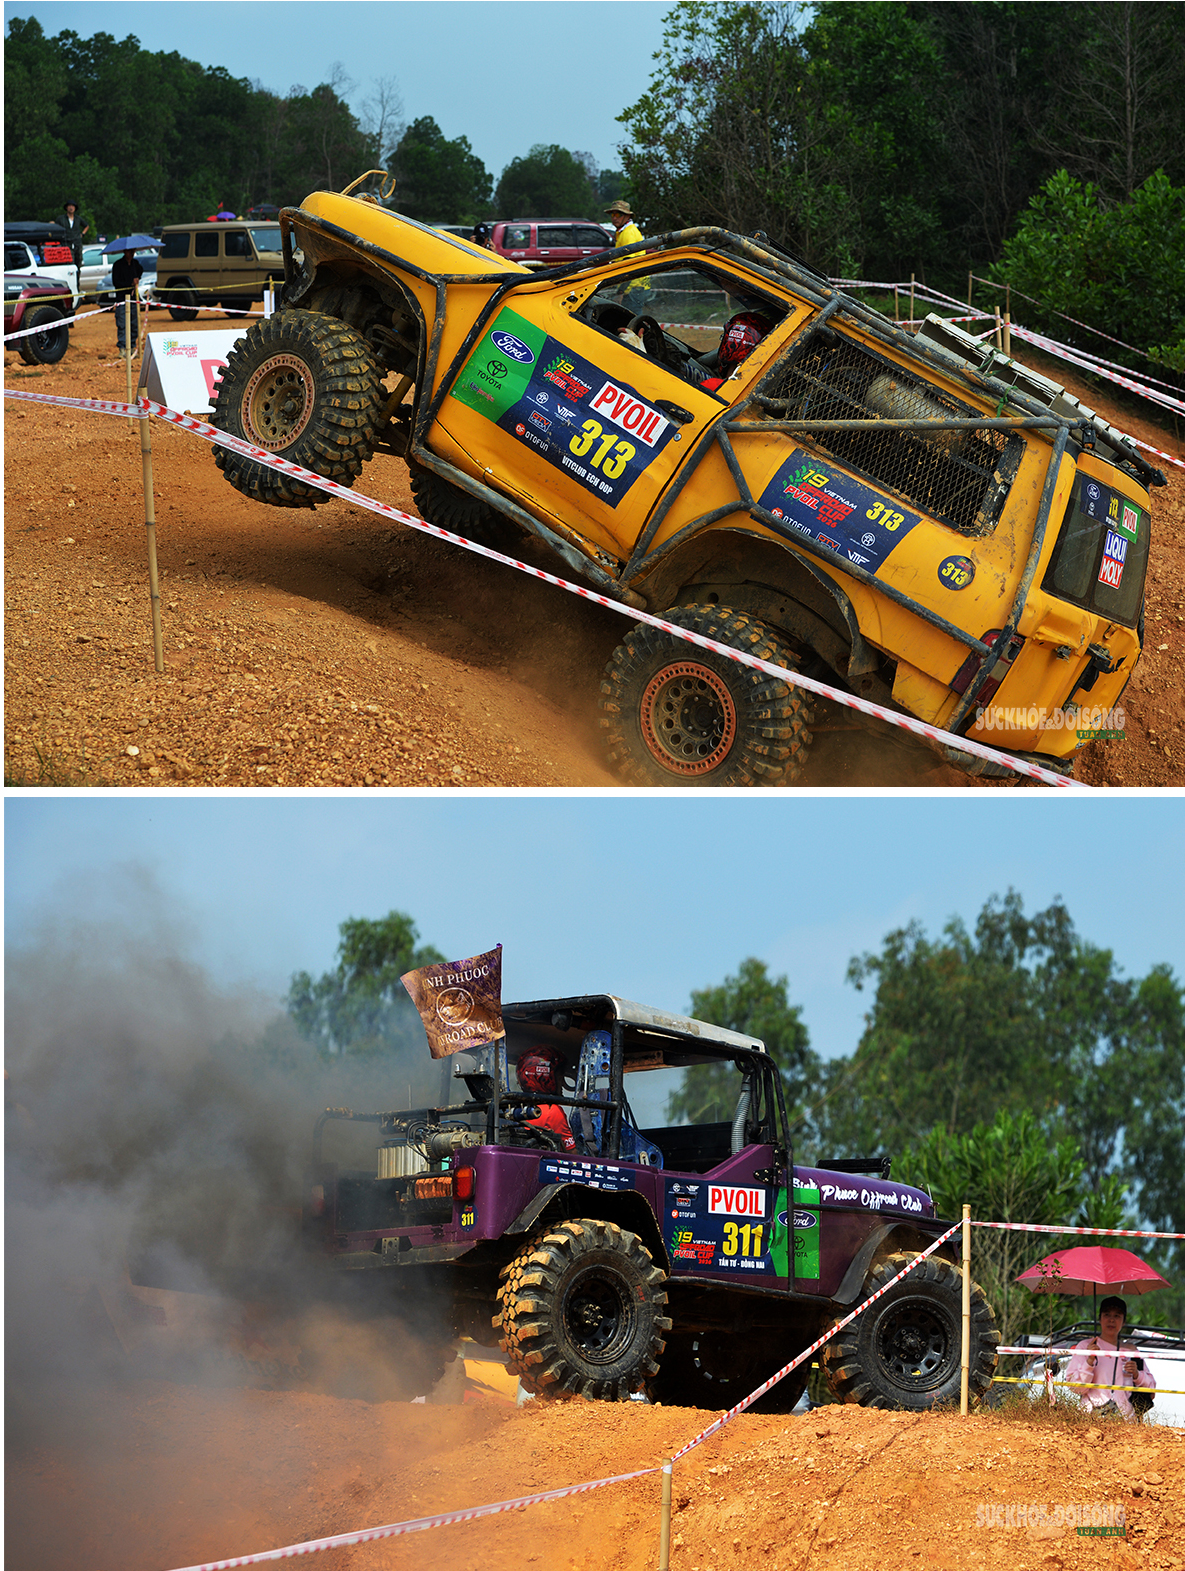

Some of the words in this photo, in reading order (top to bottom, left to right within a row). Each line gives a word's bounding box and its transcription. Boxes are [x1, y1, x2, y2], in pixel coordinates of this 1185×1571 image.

[497, 335, 527, 360] Ford
[556, 359, 575, 375] 19
[477, 370, 502, 390] TOYOTA
[543, 370, 568, 390] PVOIL
[565, 385, 584, 398] CUP
[553, 369, 590, 395] OFFROAD
[570, 373, 593, 390] VIETNAM
[593, 384, 661, 444] PVOIL
[568, 418, 636, 480] 313
[802, 468, 830, 488] 19
[783, 484, 820, 511] PVOIL
[817, 504, 846, 522] CUP
[797, 481, 854, 516] OFFROAD
[823, 487, 858, 510] VIETNAM
[816, 513, 838, 529] 2026
[865, 501, 905, 532] 313
[1122, 507, 1137, 533] PVOIL
[1105, 532, 1127, 562] LIQUI
[941, 562, 969, 586] 313
[1100, 558, 1123, 586] MOLY
[447, 964, 490, 985] PHUOC
[711, 1187, 763, 1215] PVOIL
[900, 1194, 923, 1213] Club
[461, 1212, 474, 1227] 311
[677, 1231, 694, 1243] 19
[679, 1242, 715, 1252] OFFROAD
[722, 1221, 764, 1257] 311
[673, 1249, 697, 1259] PVOIL
[697, 1251, 714, 1259] CUP
